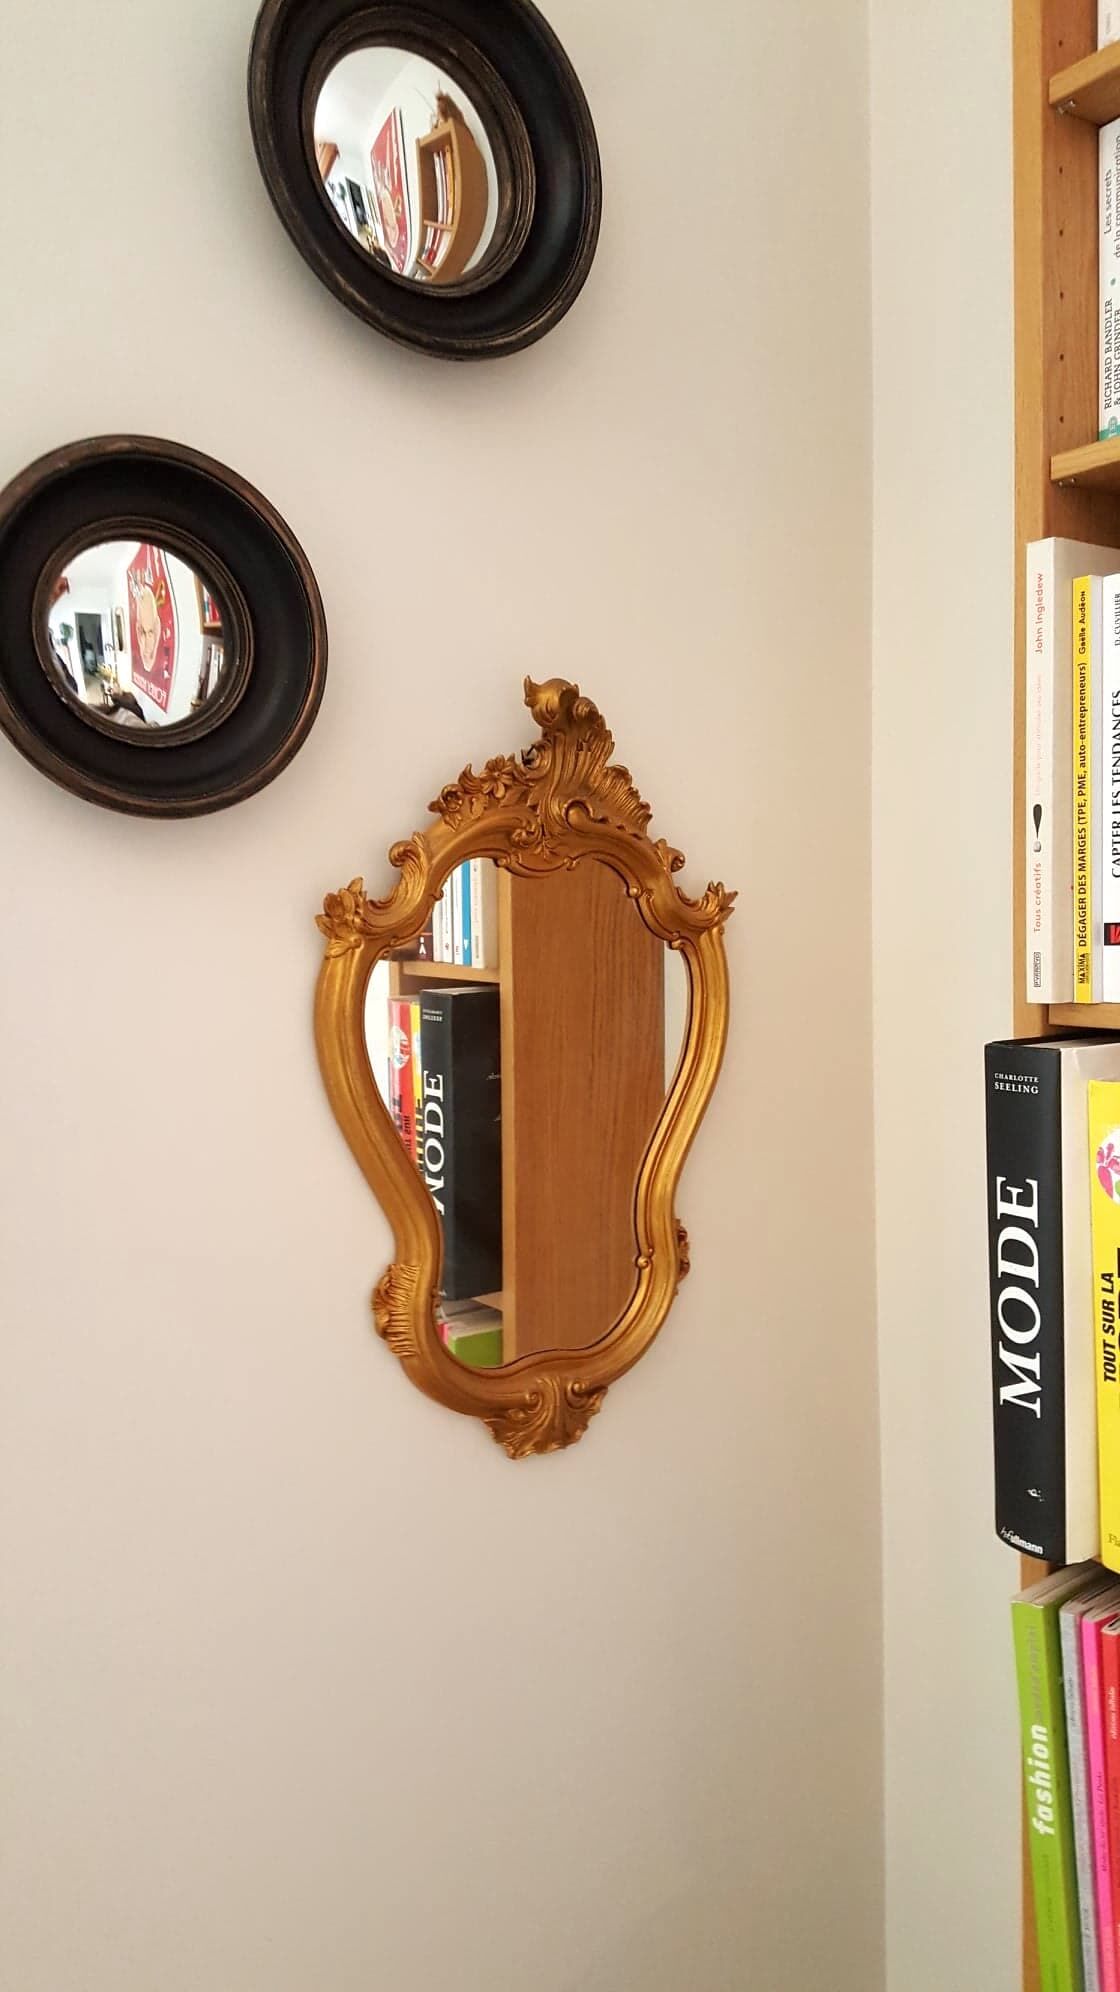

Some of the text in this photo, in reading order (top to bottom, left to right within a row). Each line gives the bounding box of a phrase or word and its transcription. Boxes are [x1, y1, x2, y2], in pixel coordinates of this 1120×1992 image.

[1103, 168, 1112, 235] Les secrets
[1104, 297, 1113, 354] BANDLER
[1104, 356, 1113, 410] RICHARD
[1034, 573, 1046, 655] John Ingledew
[1076, 662, 1088, 947] DÉGAGER DES MARGES (TPE, PME, auto-entrepreneurs)
[1111, 689, 1120, 878] CAPTER LES TENDANCES
[1033, 862, 1042, 933] Tous créatifs
[994, 1072, 1039, 1082] CHARLOTTE
[994, 1082, 1039, 1094] SEELING
[995, 1175, 1042, 1419] MODE
[1101, 1272, 1117, 1383] TOUT SUR LA
[1026, 1724, 1055, 1836] fashion
